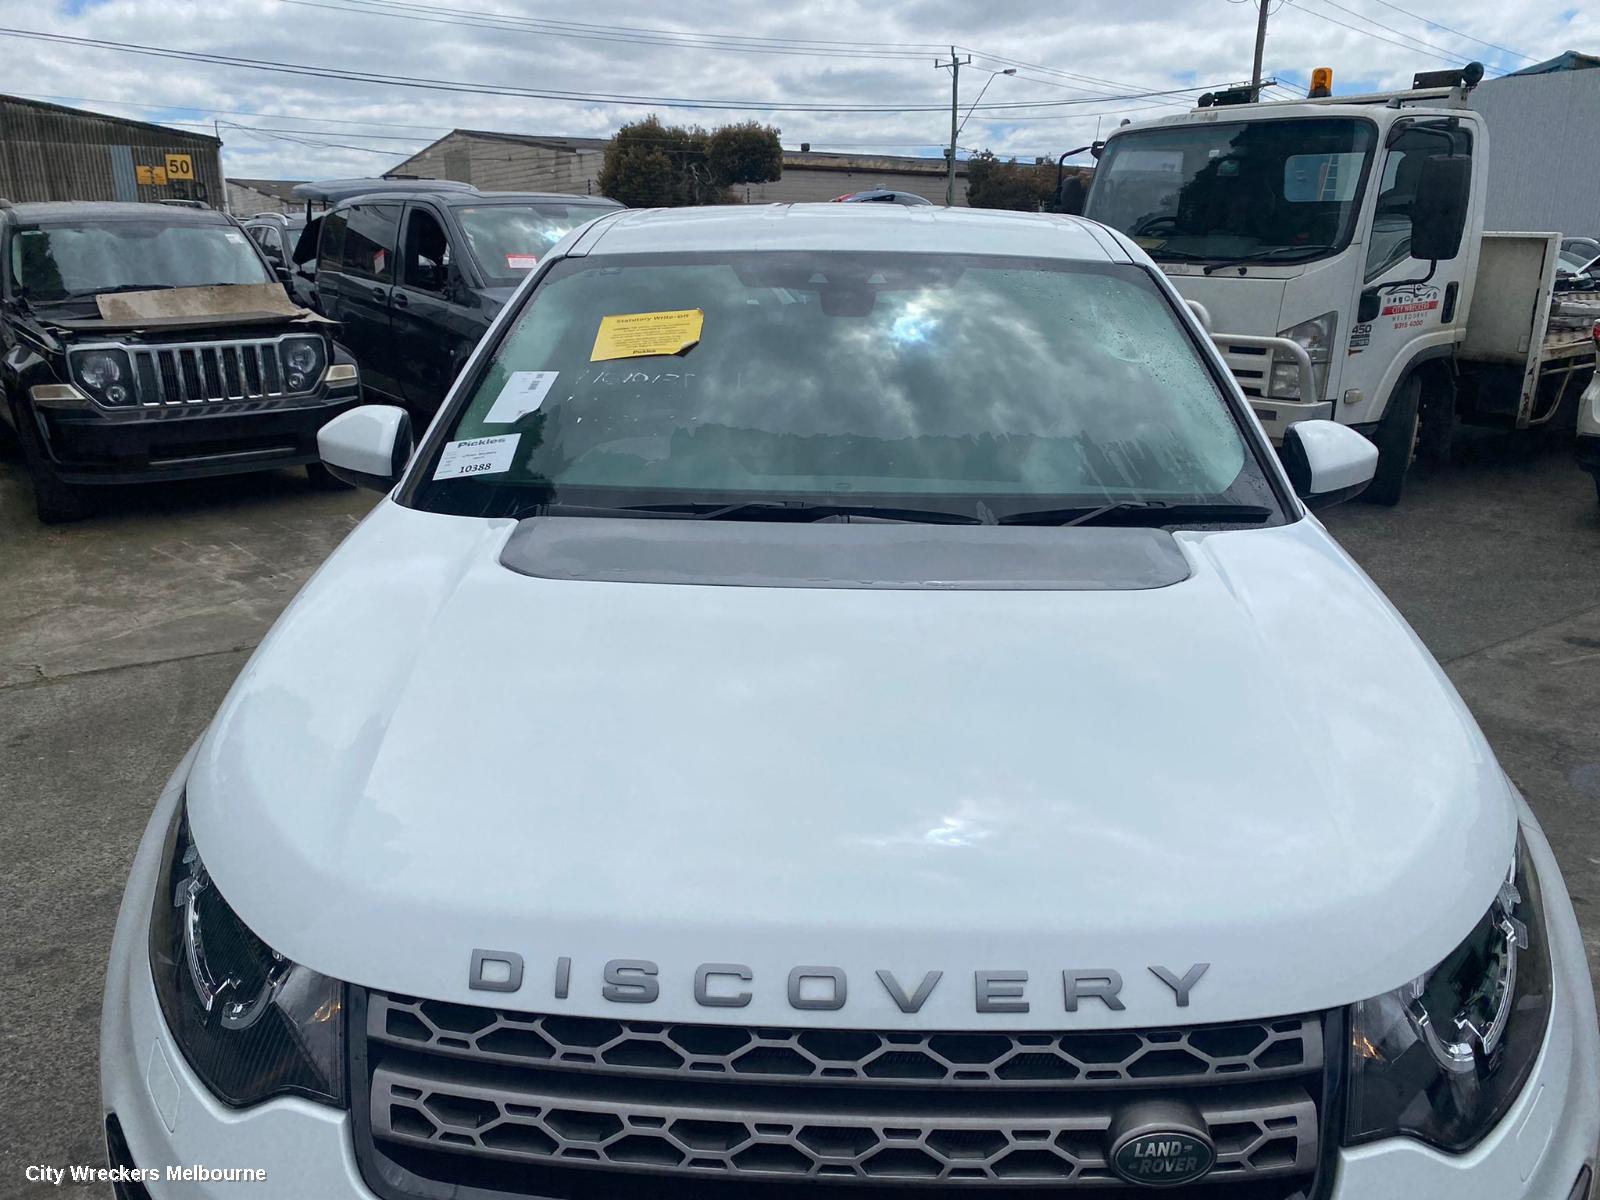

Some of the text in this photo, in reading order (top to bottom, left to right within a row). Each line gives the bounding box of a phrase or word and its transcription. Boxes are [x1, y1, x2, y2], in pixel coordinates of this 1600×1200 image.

[169, 159, 190, 174] 50
[616, 315, 652, 324] Statutory
[1351, 324, 1372, 334] 450
[457, 438, 507, 449] Pickles
[458, 462, 492, 474] 10388
[469, 948, 1211, 1013] DISCOVERY
